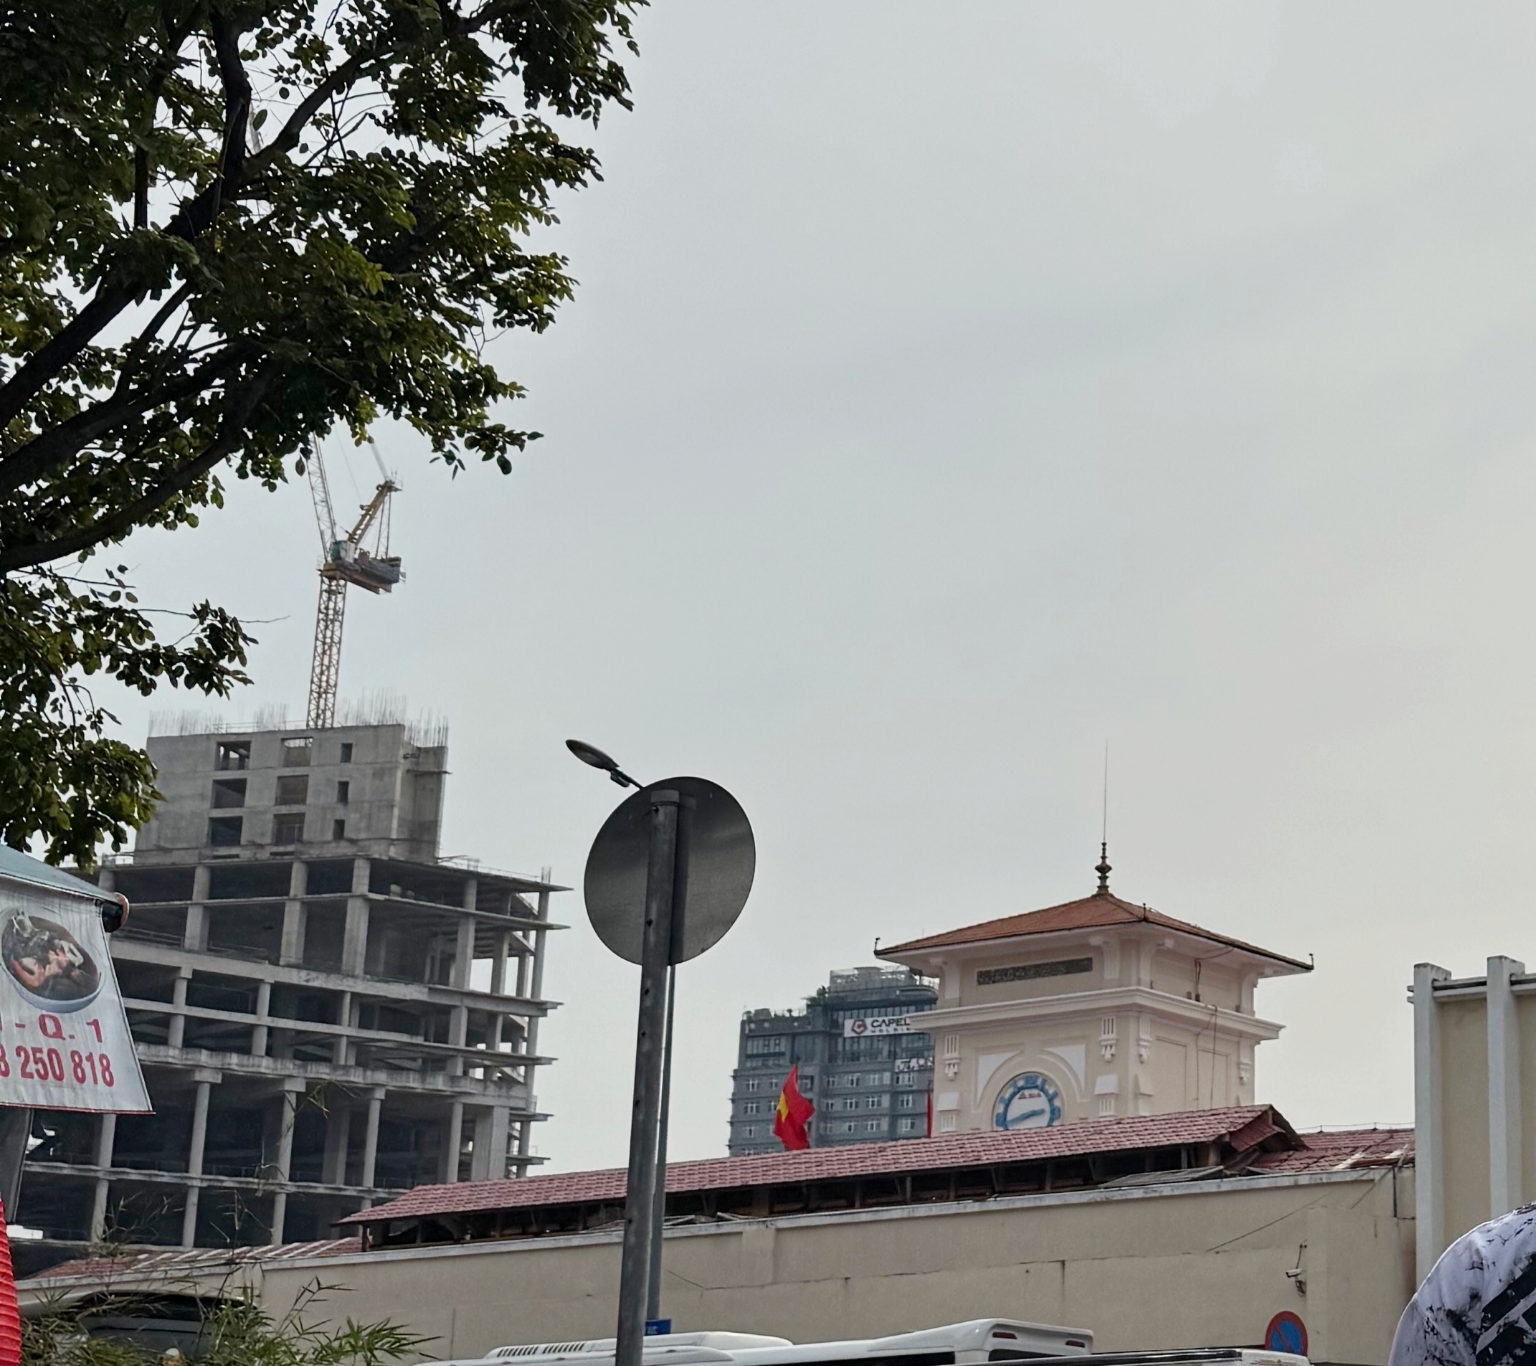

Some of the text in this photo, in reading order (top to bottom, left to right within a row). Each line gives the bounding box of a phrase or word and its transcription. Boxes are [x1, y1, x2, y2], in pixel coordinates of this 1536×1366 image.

[86, 1019, 102, 1043] 1
[16, 1046, 64, 1082] 250
[70, 1050, 114, 1087] 818
